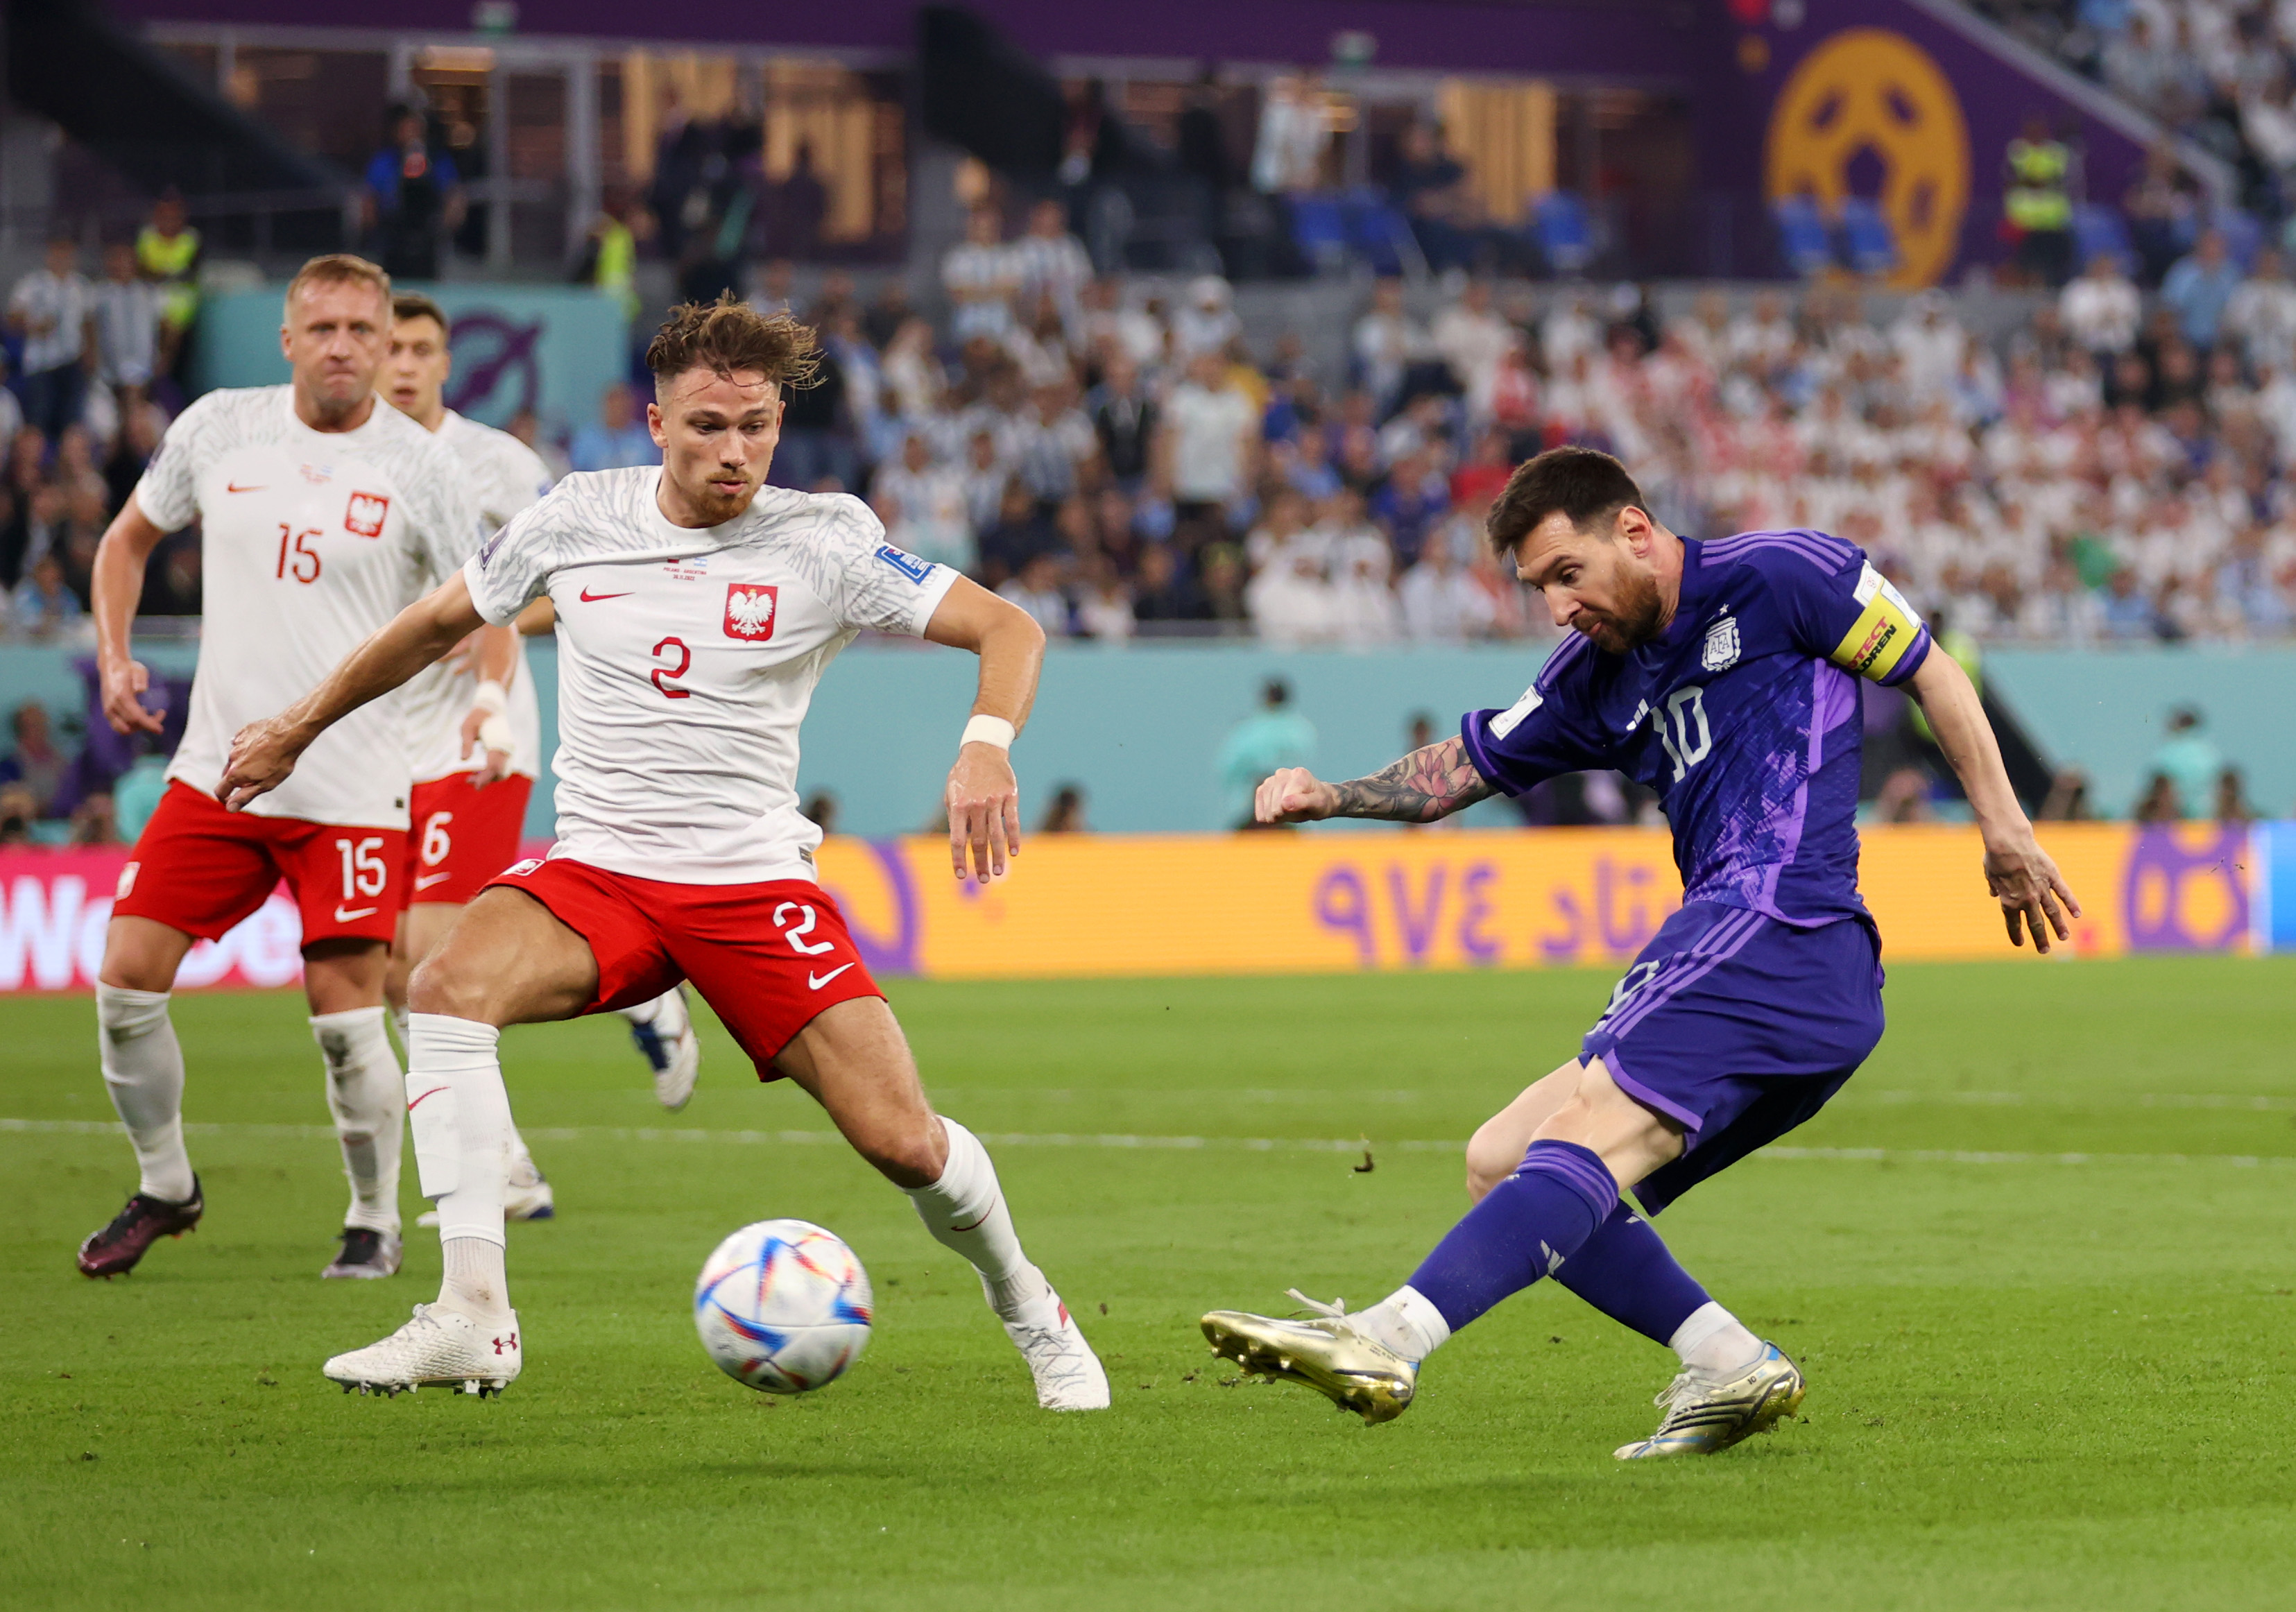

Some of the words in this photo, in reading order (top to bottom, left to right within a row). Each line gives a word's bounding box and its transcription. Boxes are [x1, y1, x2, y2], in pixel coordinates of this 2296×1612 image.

[276, 523, 323, 584] 15
[651, 636, 691, 698] 2
[1709, 631, 1730, 655] AFA
[1848, 616, 1887, 669] OTECT
[1860, 624, 1896, 672] LDREN
[1650, 685, 1712, 784] 10
[422, 812, 452, 866] 6
[336, 837, 386, 899] 15
[771, 901, 835, 955] 2
[1747, 1376, 1756, 1384] 10
